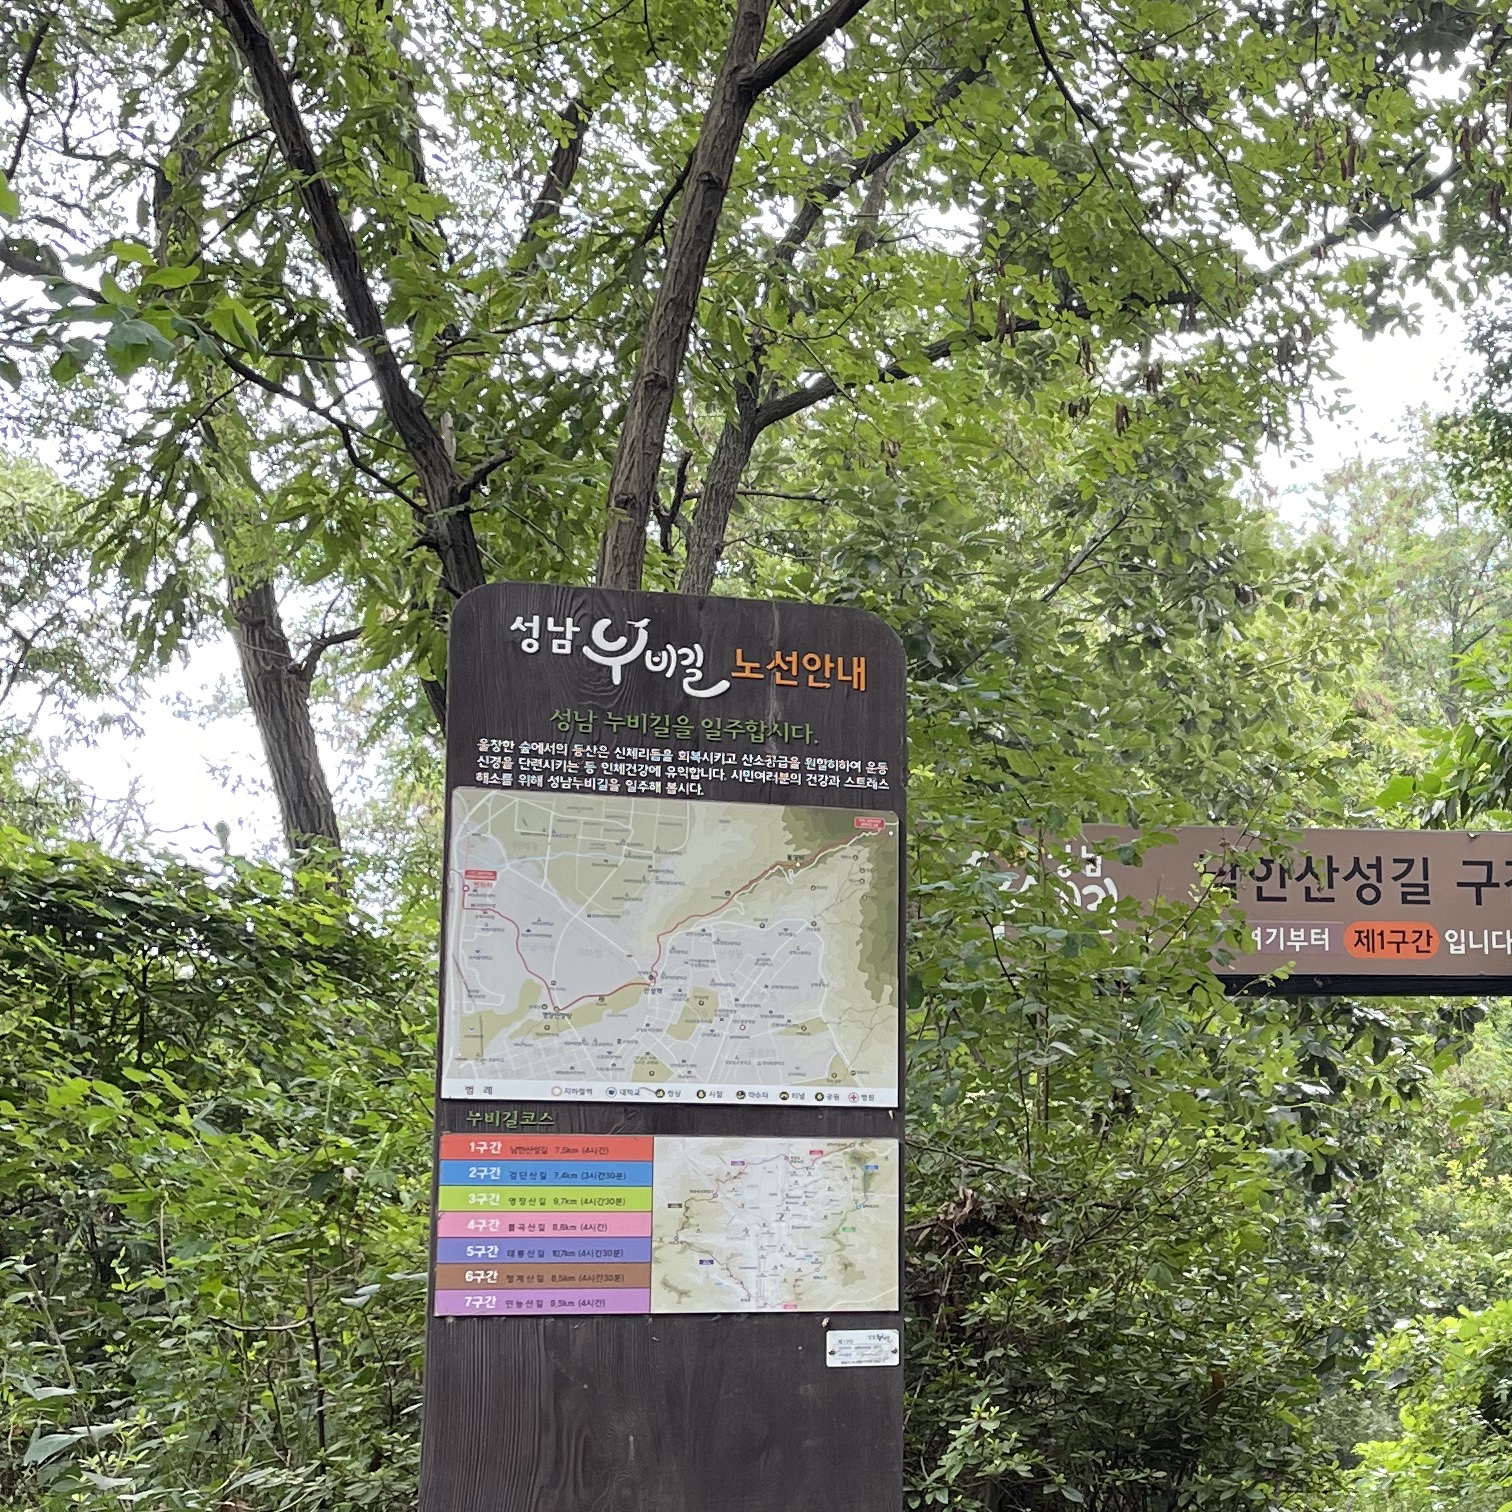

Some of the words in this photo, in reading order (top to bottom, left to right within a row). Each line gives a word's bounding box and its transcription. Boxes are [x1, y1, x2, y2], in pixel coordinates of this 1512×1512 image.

[510, 613, 581, 655] 성남
[582, 617, 731, 698] 누비길
[731, 647, 867, 692] 노선안내
[550, 709, 599, 734] 성남
[604, 711, 697, 740] 누비길을
[701, 718, 820, 746] 일주합시다.
[476, 737, 515, 753] 울창한
[518, 741, 568, 756] 숲에서의
[571, 744, 609, 759] 등산은
[677, 750, 737, 766] 회복시키고
[865, 761, 889, 775] 운동
[476, 755, 515, 770] 신경을
[518, 757, 580, 773] 단련시키는
[584, 761, 597, 774] 등
[601, 762, 662, 778] 인체건강에
[731, 769, 802, 785] 시민여러분의
[805, 773, 841, 788] 건강과
[843, 776, 890, 790] 스트레스
[475, 771, 513, 787] 해소를
[518, 773, 543, 788] 위해
[547, 775, 621, 792] 성남누비길을
[625, 778, 662, 794] 일주해
[1353, 928, 1434, 954] 제1구간
[466, 1110, 555, 1129] 누비길코스
[469, 1141, 502, 1154] 1구간
[468, 1167, 501, 1180] 2구간
[468, 1192, 500, 1206] 3구간
[467, 1218, 500, 1231] 4구간
[466, 1245, 499, 1258] 5구간
[465, 1270, 498, 1283] 6구간
[464, 1296, 497, 1309] 7구간
